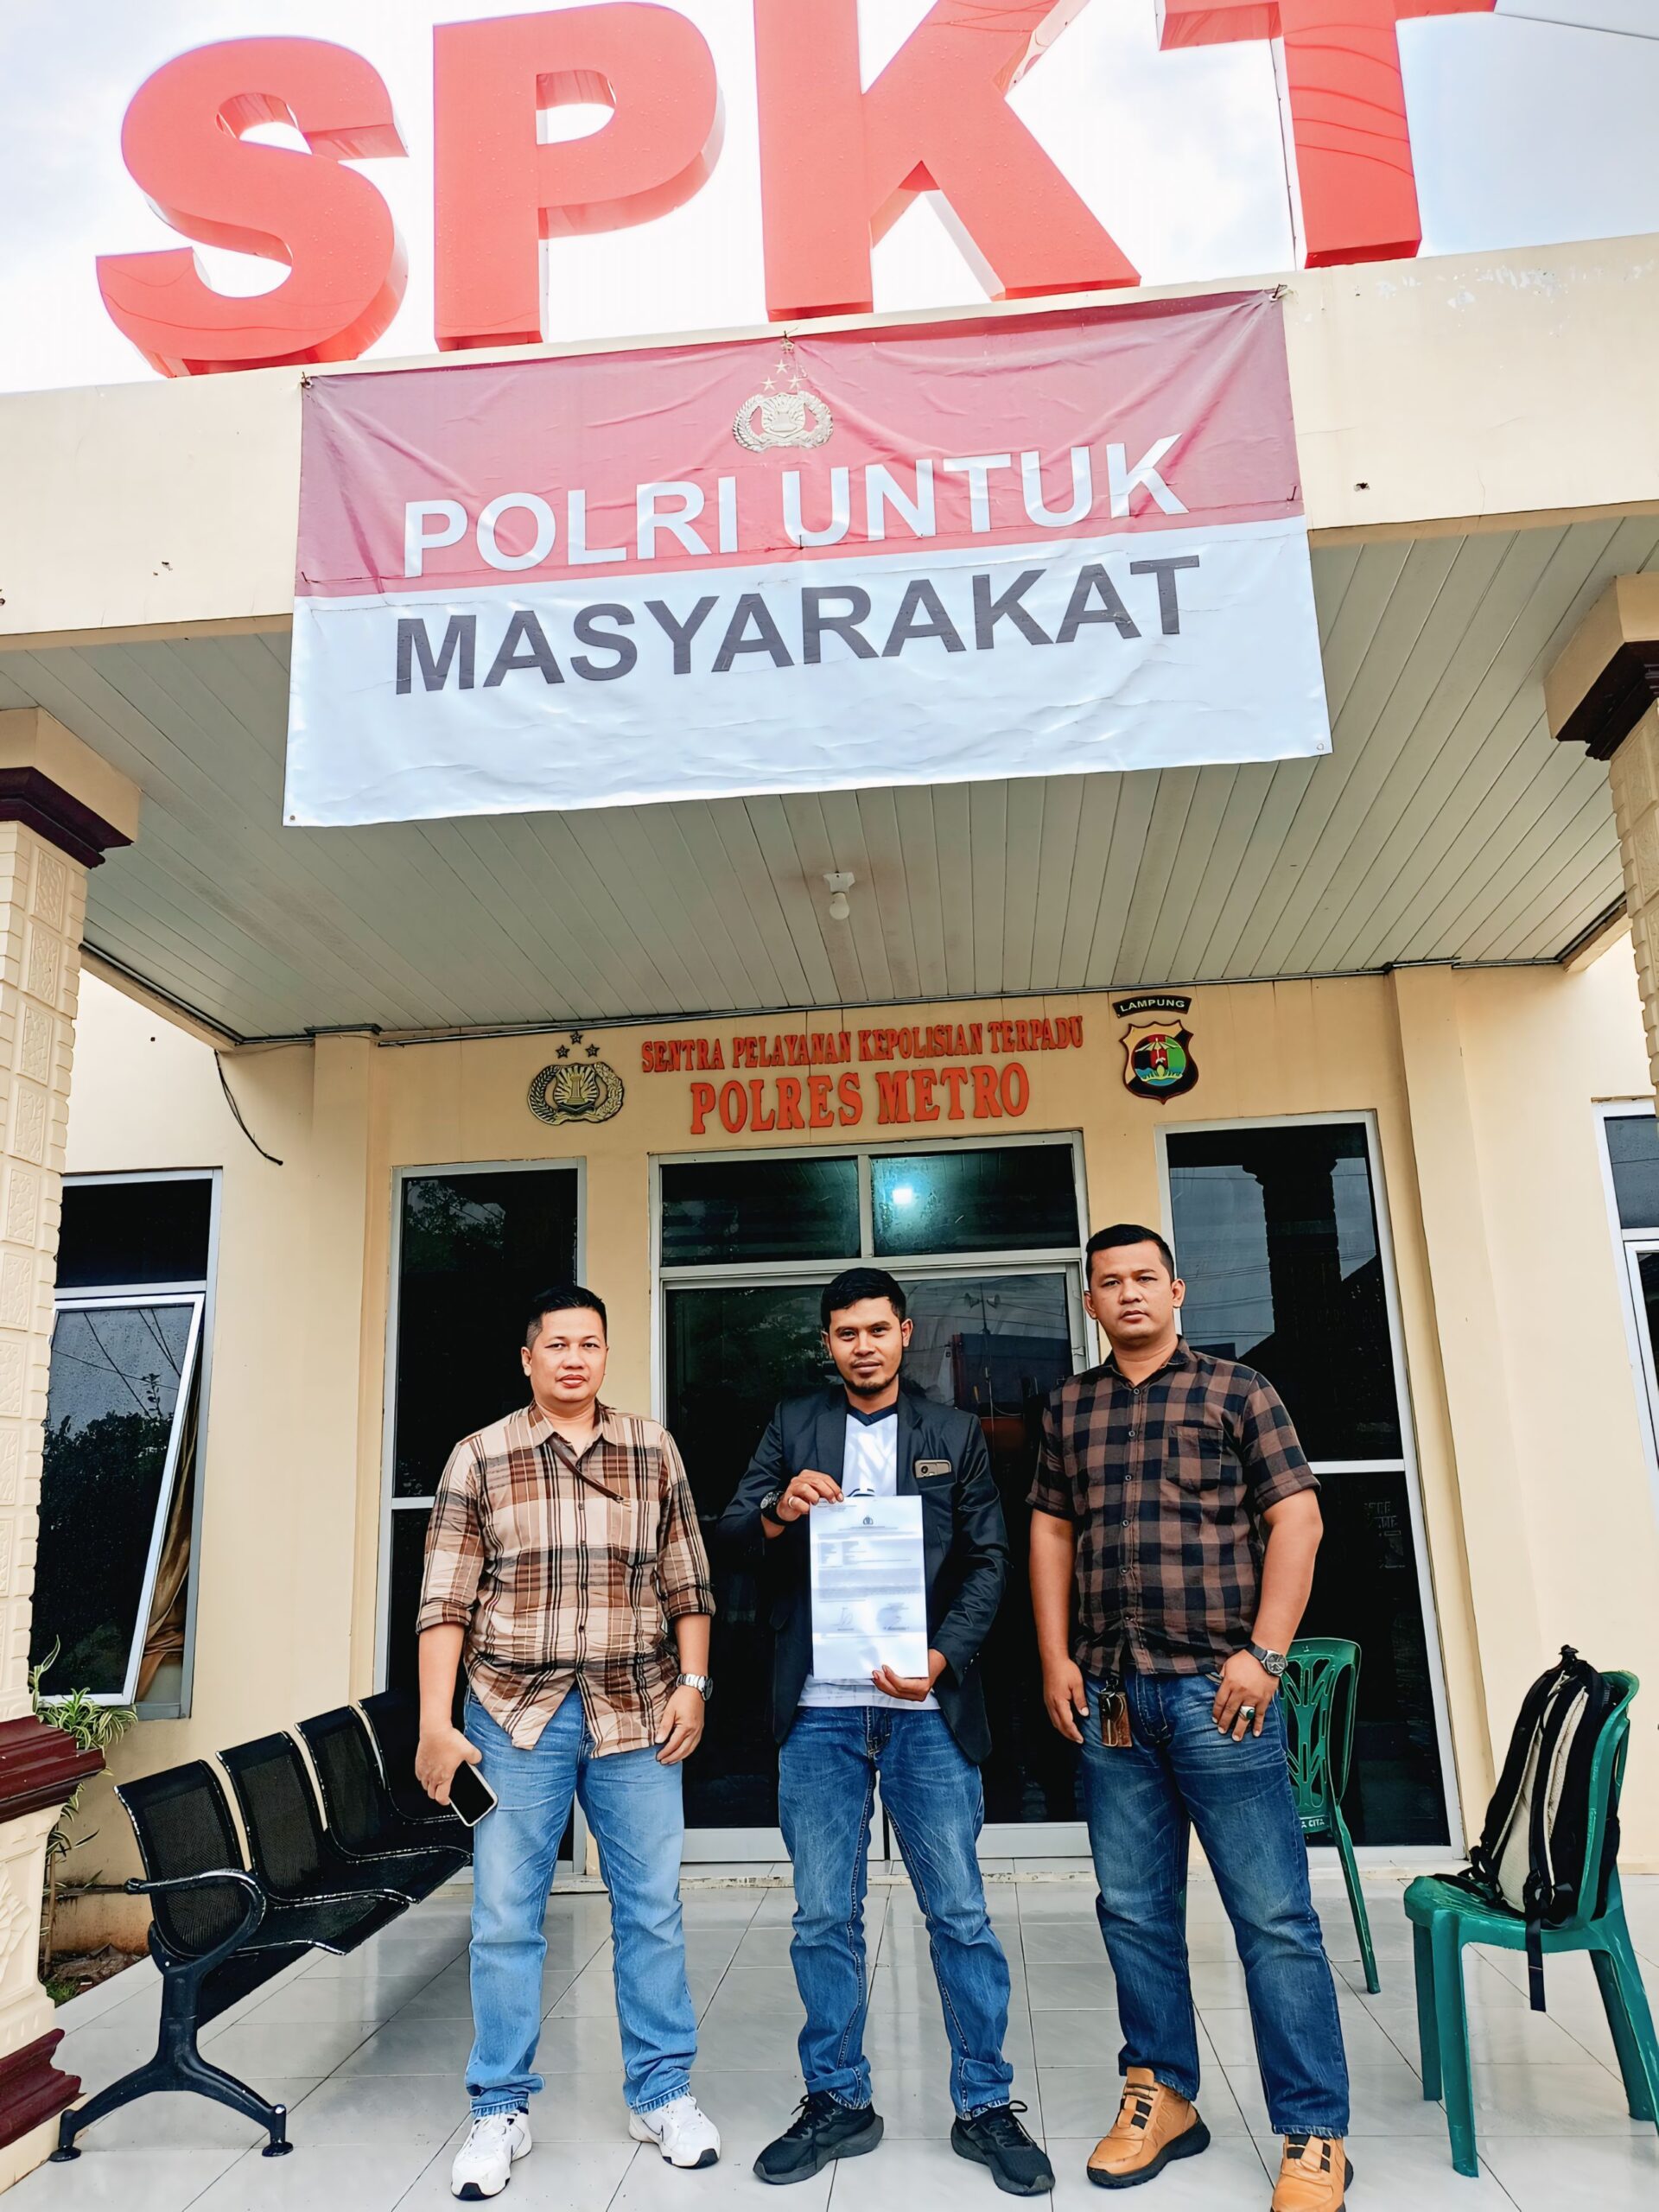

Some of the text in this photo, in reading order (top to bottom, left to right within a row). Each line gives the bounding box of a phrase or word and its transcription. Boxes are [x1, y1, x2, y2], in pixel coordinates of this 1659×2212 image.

[97, 0, 1497, 378] SPKT
[404, 432, 1190, 579] POLRI UNTUK
[395, 554, 1200, 696] MASYARAKAT
[641, 1015, 1084, 1073] SENTRA PELAYANAN KEPOLISIAN TERPADU
[1120, 999, 1185, 1013] LAMPUNG
[690, 1061, 1030, 1135] POLRES METRO
